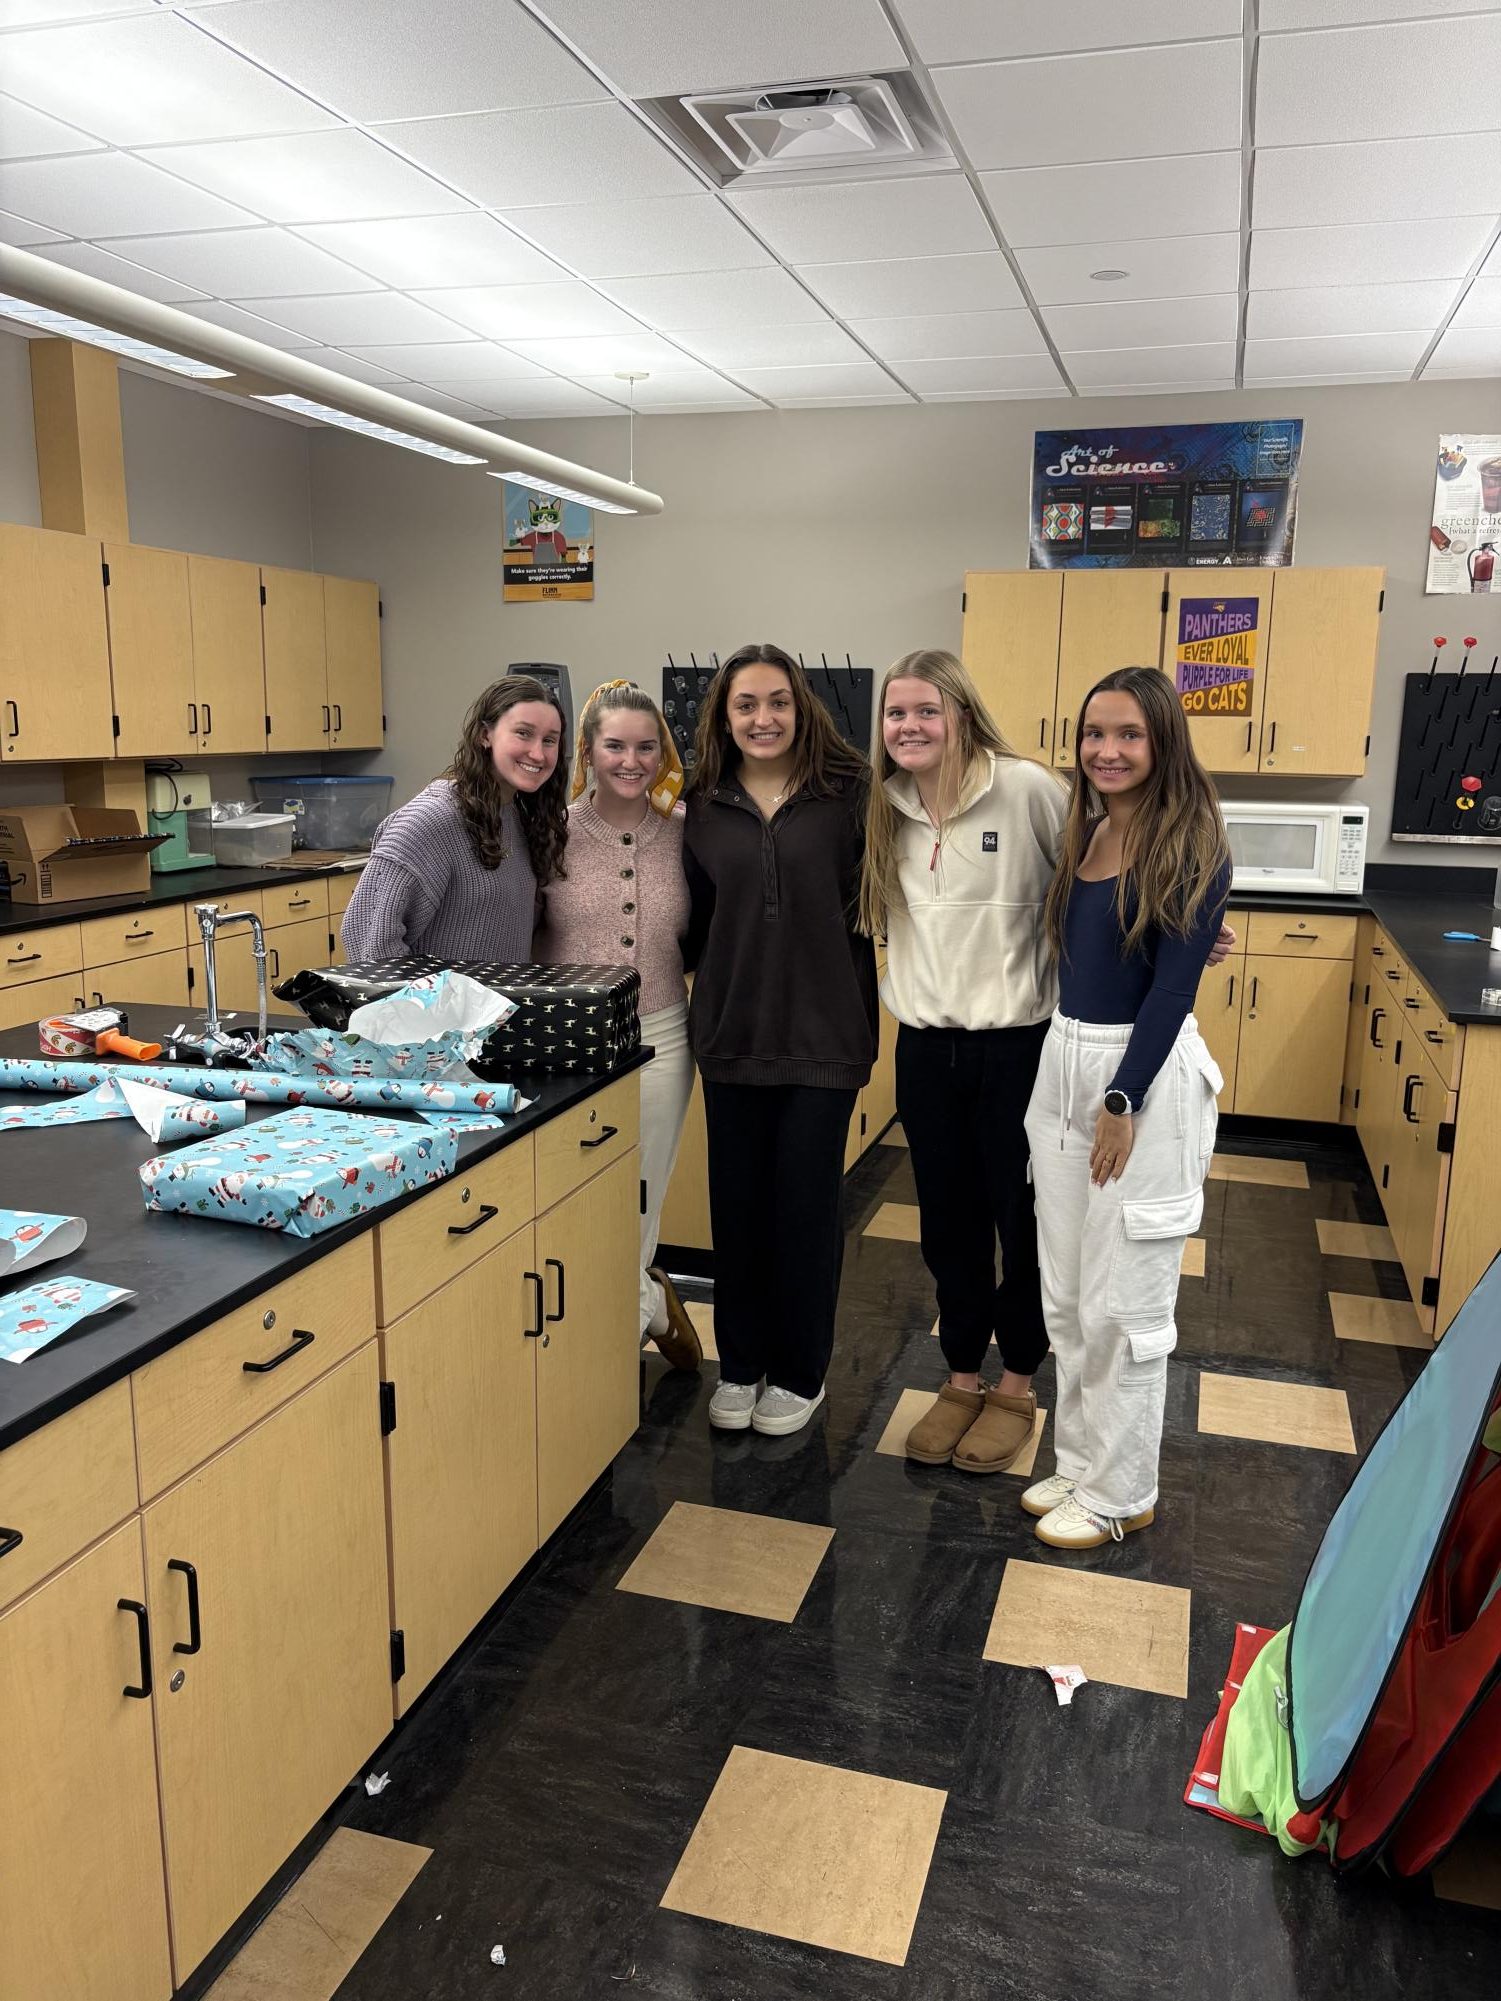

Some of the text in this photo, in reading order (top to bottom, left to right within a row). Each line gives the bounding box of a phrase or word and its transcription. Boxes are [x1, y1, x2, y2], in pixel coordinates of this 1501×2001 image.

[1061, 445, 1120, 458] Art of
[1046, 455, 1168, 476] Science
[537, 567, 555, 575] they're
[1184, 613, 1252, 641] PANTHERS
[1183, 635, 1249, 666] EVER LOYAL
[1182, 665, 1249, 691] PURPLE FOR LIFE
[1182, 681, 1247, 711] GO CATS
